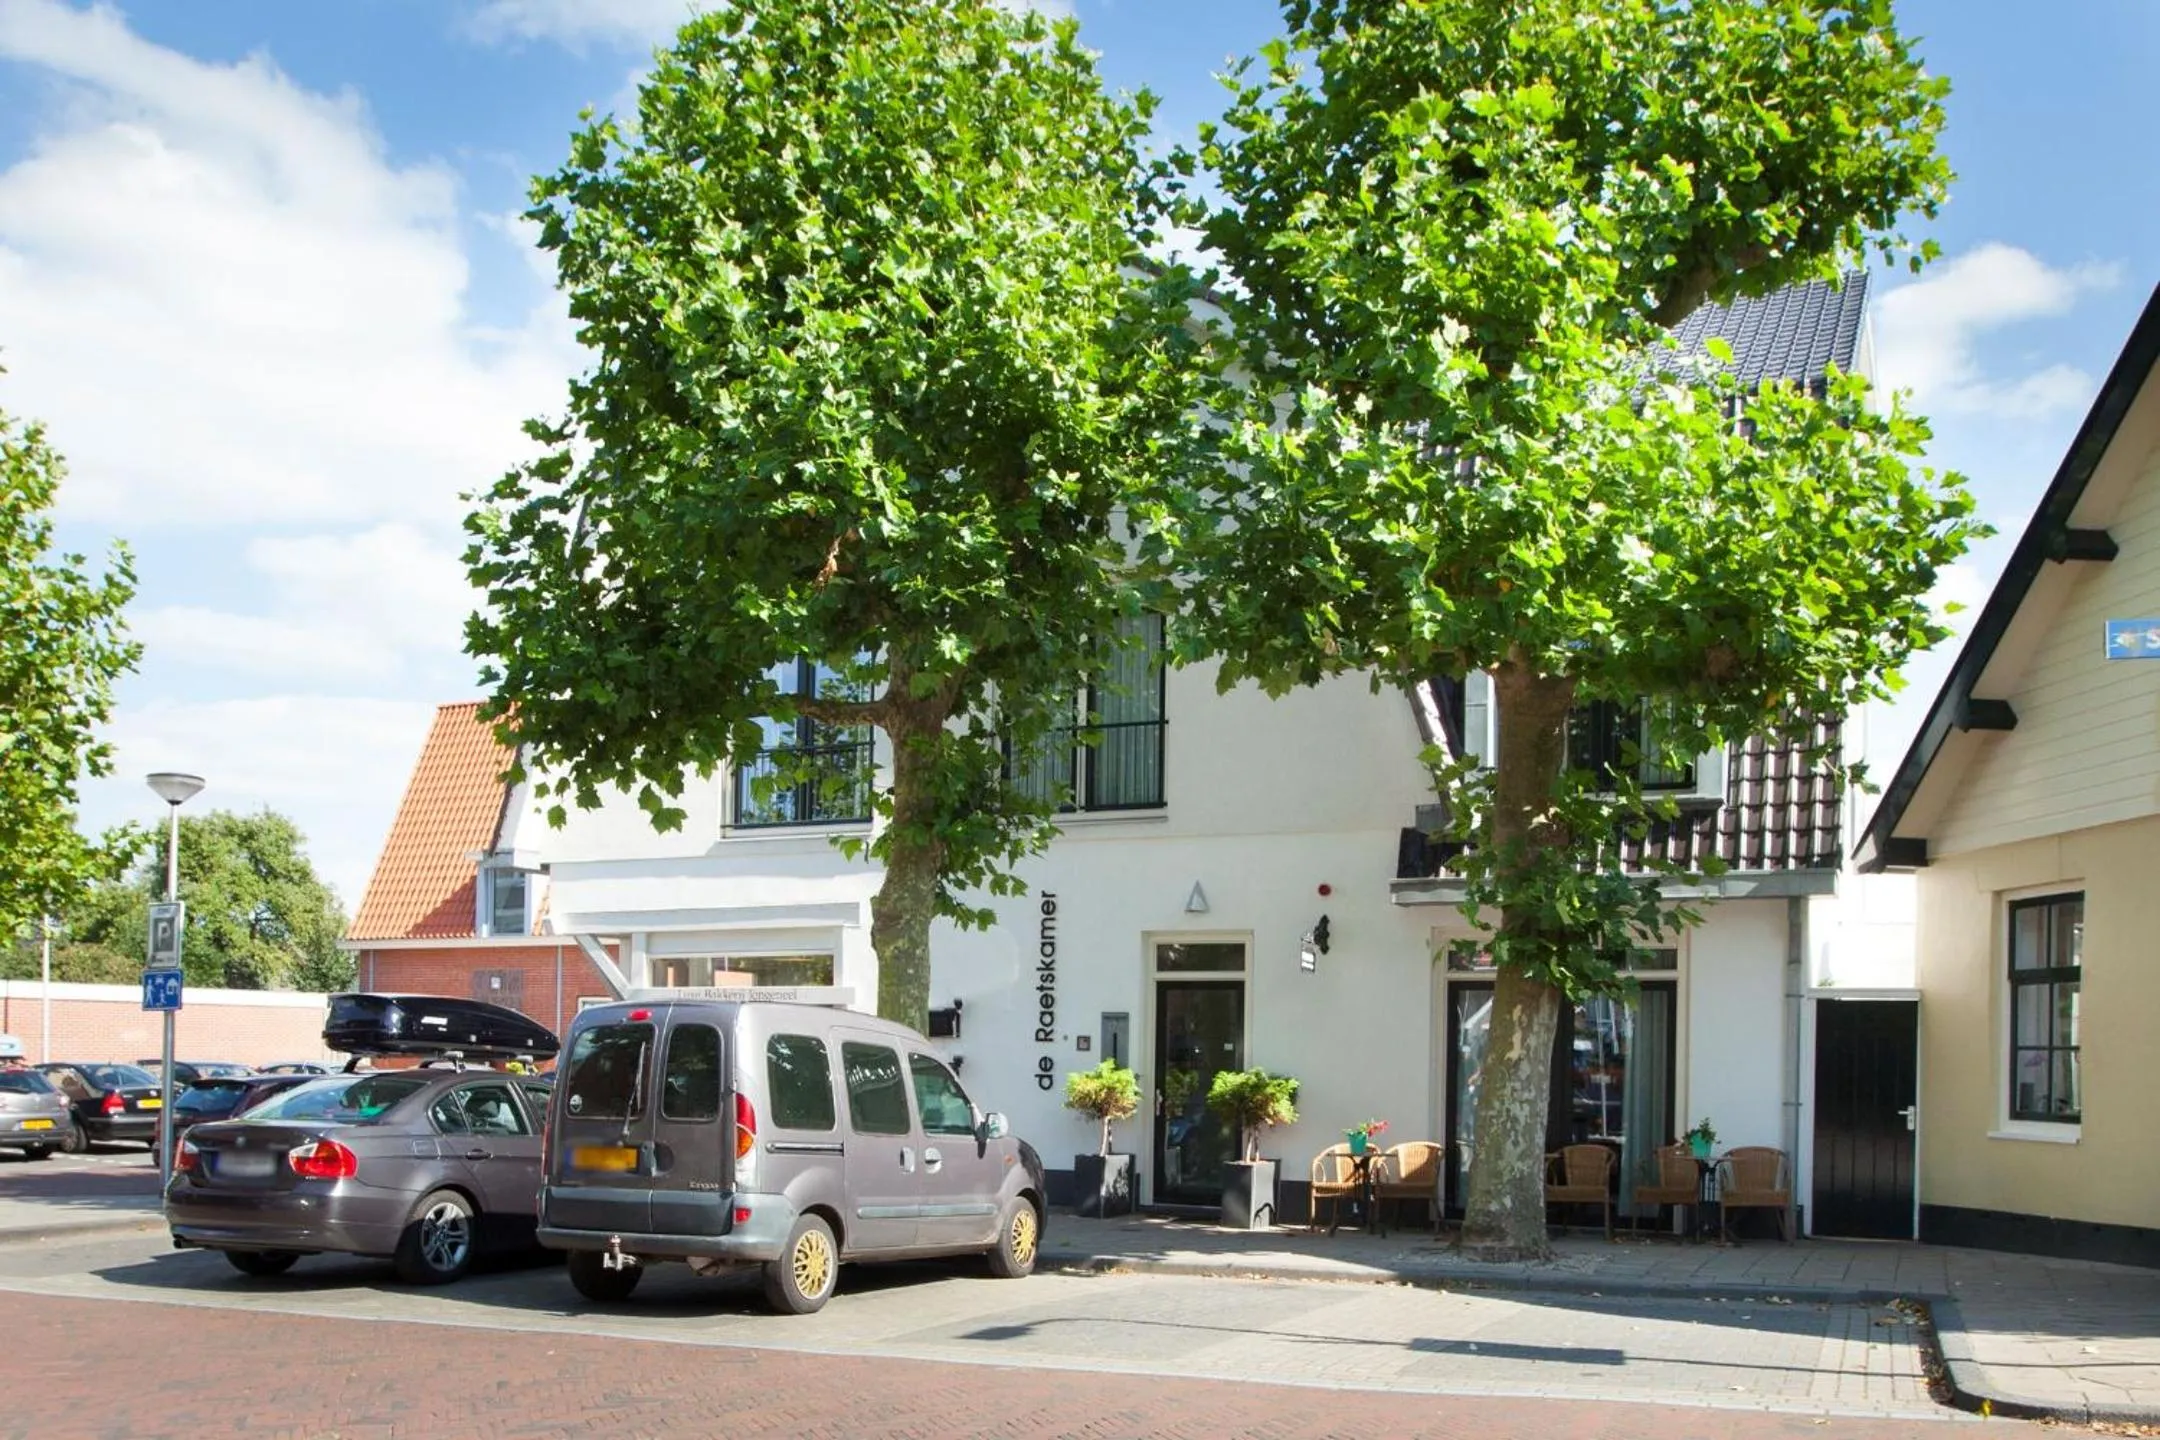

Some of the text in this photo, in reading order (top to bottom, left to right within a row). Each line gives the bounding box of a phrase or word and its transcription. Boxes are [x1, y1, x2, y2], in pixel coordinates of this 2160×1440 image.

[157, 921, 170, 950] P
[1034, 890, 1057, 1090] de Raetskamer
